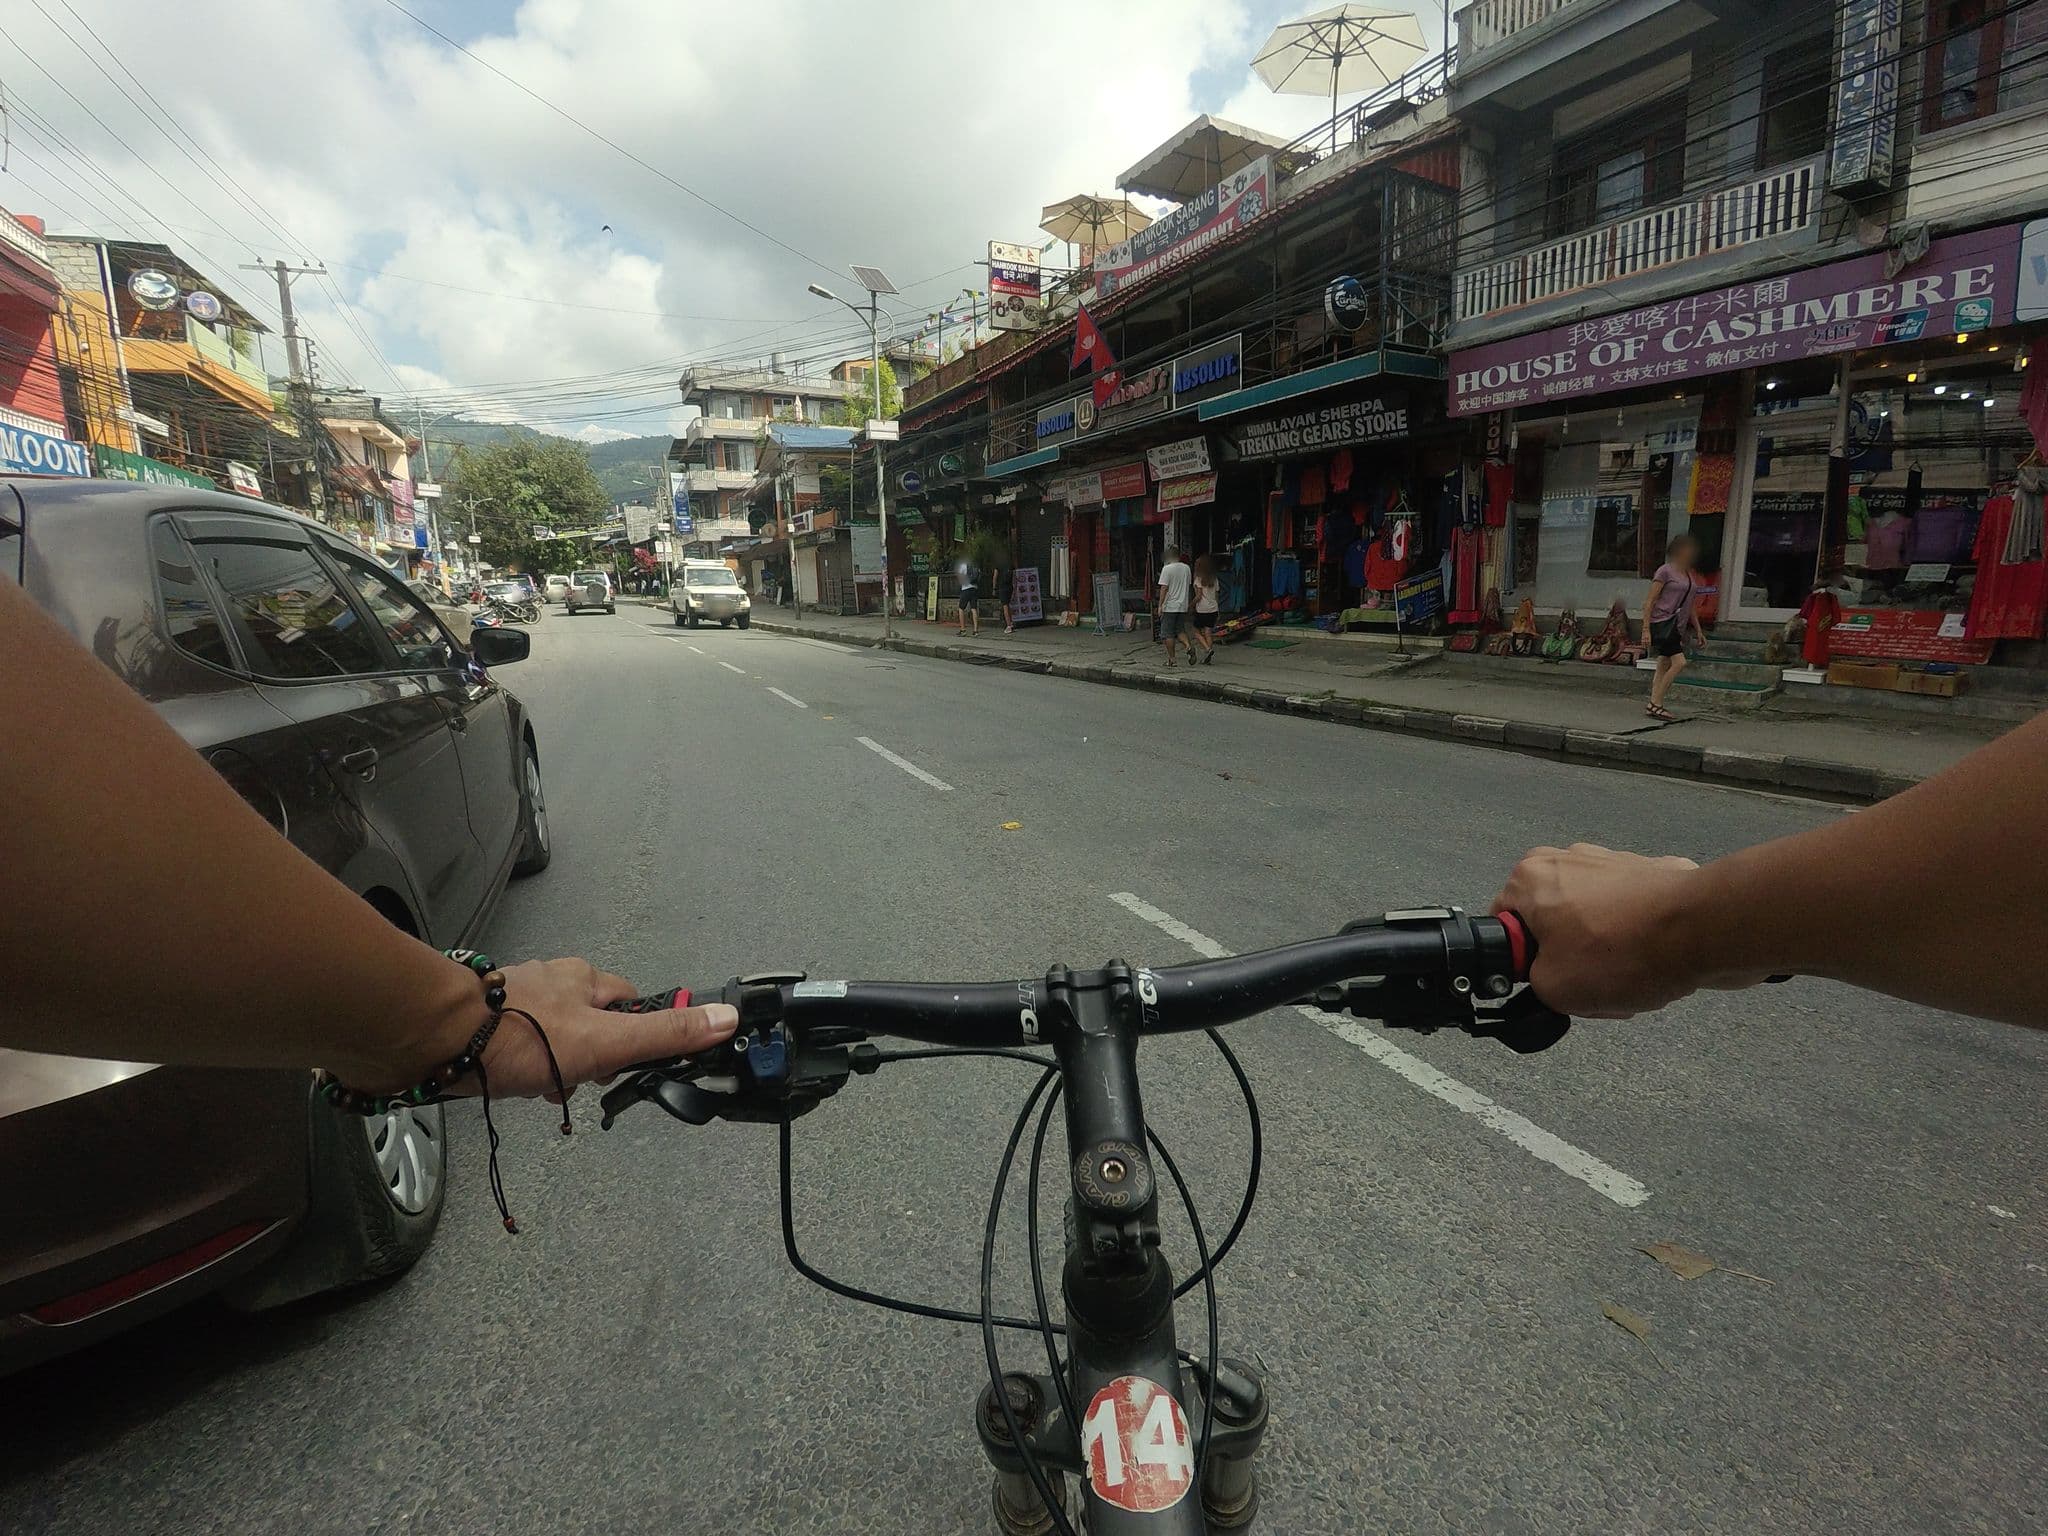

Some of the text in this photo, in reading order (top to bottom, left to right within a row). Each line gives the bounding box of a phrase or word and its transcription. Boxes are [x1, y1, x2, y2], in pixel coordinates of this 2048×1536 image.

[1134, 188, 1215, 249] HANKOOK SARANG
[1118, 216, 1235, 289] KOREAN RESTAURANT
[1455, 349, 1578, 394] HOUSE
[1588, 334, 1650, 367] OF
[1661, 264, 1996, 351] CASHMERE
[1567, 277, 1788, 347] 我愛喀什米爾
[1238, 431, 1301, 456] TREKKING
[1302, 420, 1351, 445] GEARS
[1354, 408, 1408, 437] STORE
[1247, 398, 1385, 437] HIMALAYAN SHERPA
[0, 427, 83, 475] MOON
[913, 554, 929, 562] TEA
[1082, 1395, 1195, 1488] 14
